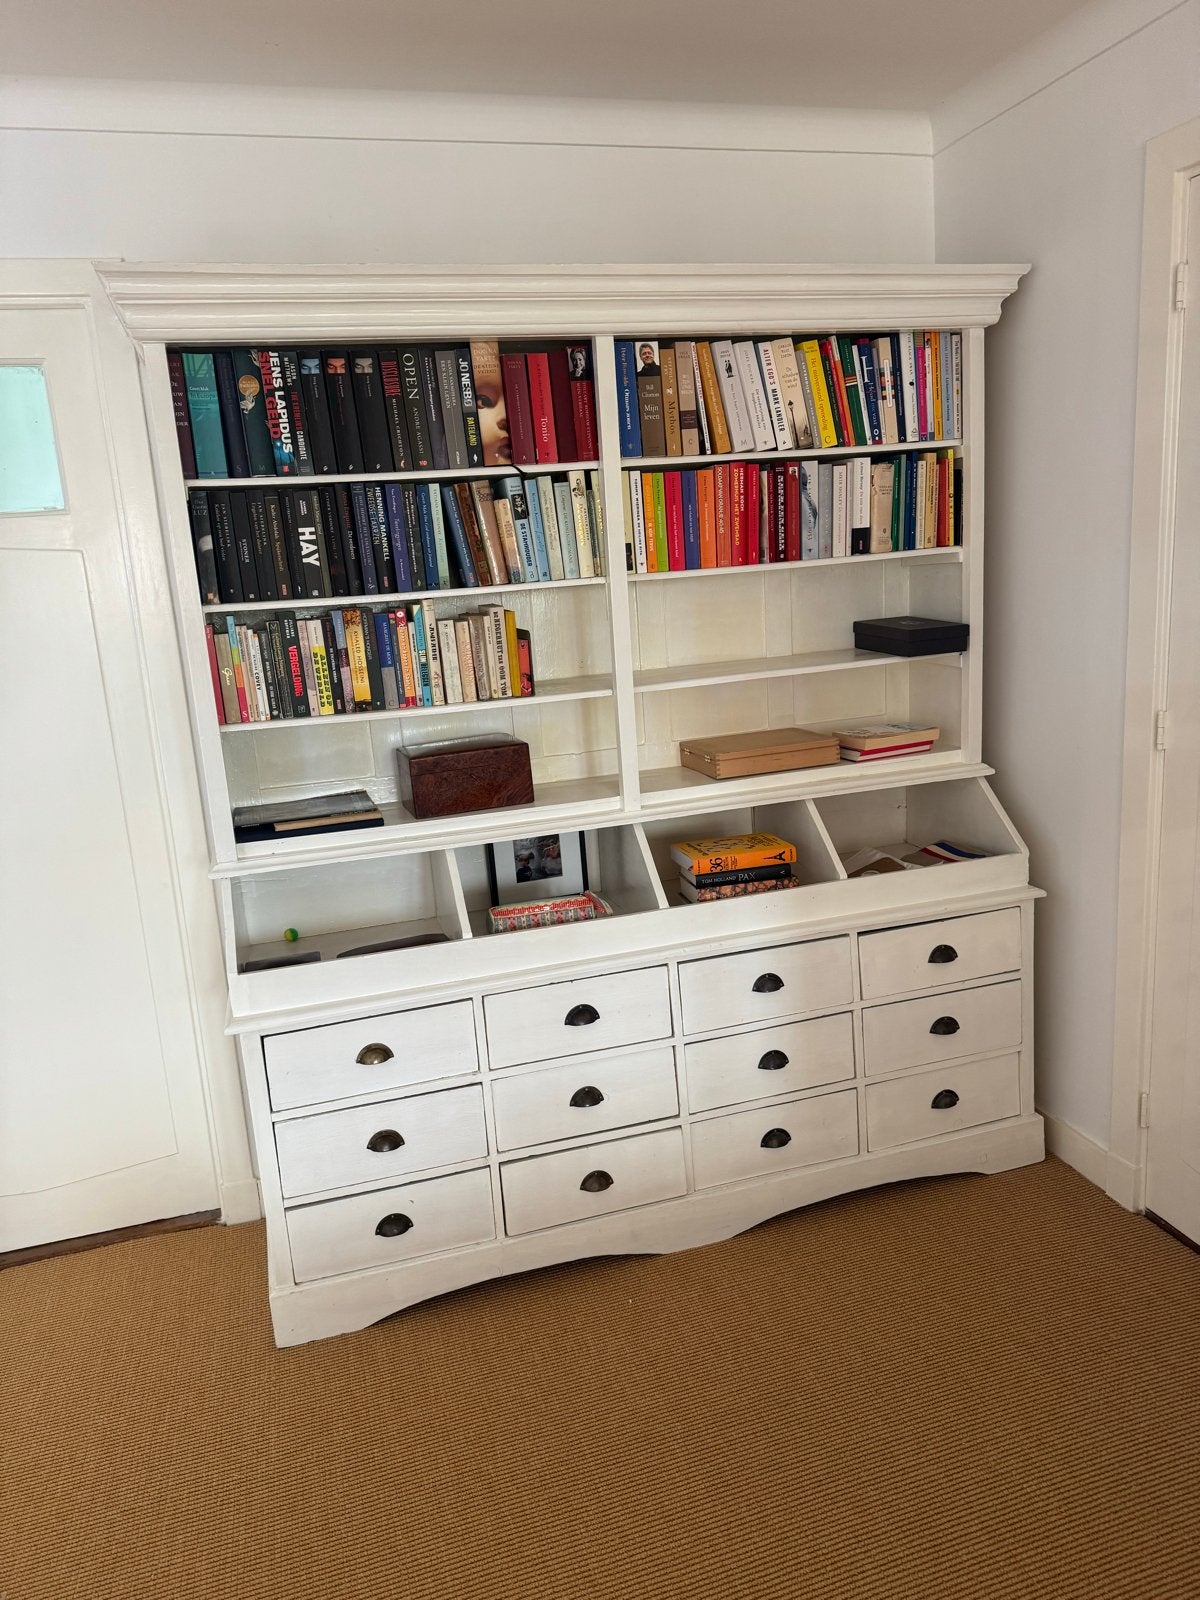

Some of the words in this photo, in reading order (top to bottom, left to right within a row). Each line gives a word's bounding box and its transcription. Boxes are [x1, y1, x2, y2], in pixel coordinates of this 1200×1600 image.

[269, 351, 283, 388] JENS
[284, 357, 293, 386] MATTHEWS
[289, 363, 297, 380] JASON
[459, 358, 469, 372] JO
[762, 349, 773, 368] ALTER
[402, 353, 420, 400] OPEN
[257, 351, 274, 394] SNEL
[267, 397, 281, 439] GELD
[443, 391, 452, 409] LEVEN
[643, 404, 660, 413] Mijn
[771, 388, 780, 406] MARK
[812, 369, 824, 403] misverstand
[818, 402, 829, 432] opvoeding
[274, 391, 293, 453] LAPIDUS
[540, 416, 550, 443] Tonio
[668, 400, 677, 436] Mythos
[774, 406, 787, 433] LANDLER
[296, 431, 308, 461] CANDIDATE
[374, 487, 385, 524] HENNING
[520, 522, 526, 530] DE
[240, 538, 250, 563] STONER
[297, 526, 321, 567] HAY
[379, 524, 390, 562] MANKELL
[521, 530, 533, 567] STAMHOUDER
[493, 618, 504, 654] NEGERHUT
[288, 645, 304, 697] VERGELDING
[312, 651, 319, 665] DE
[352, 630, 361, 654] KHALED
[357, 655, 365, 684] HOSSEINI
[314, 666, 326, 708] WERELD
[319, 654, 331, 693] ALLEEN
[325, 694, 333, 707] OP
[498, 667, 506, 683] OOM
[500, 683, 508, 697] TOM
[709, 857, 724, 873] 36
[713, 875, 737, 883] HOLLAND
[738, 871, 757, 882] PAX
